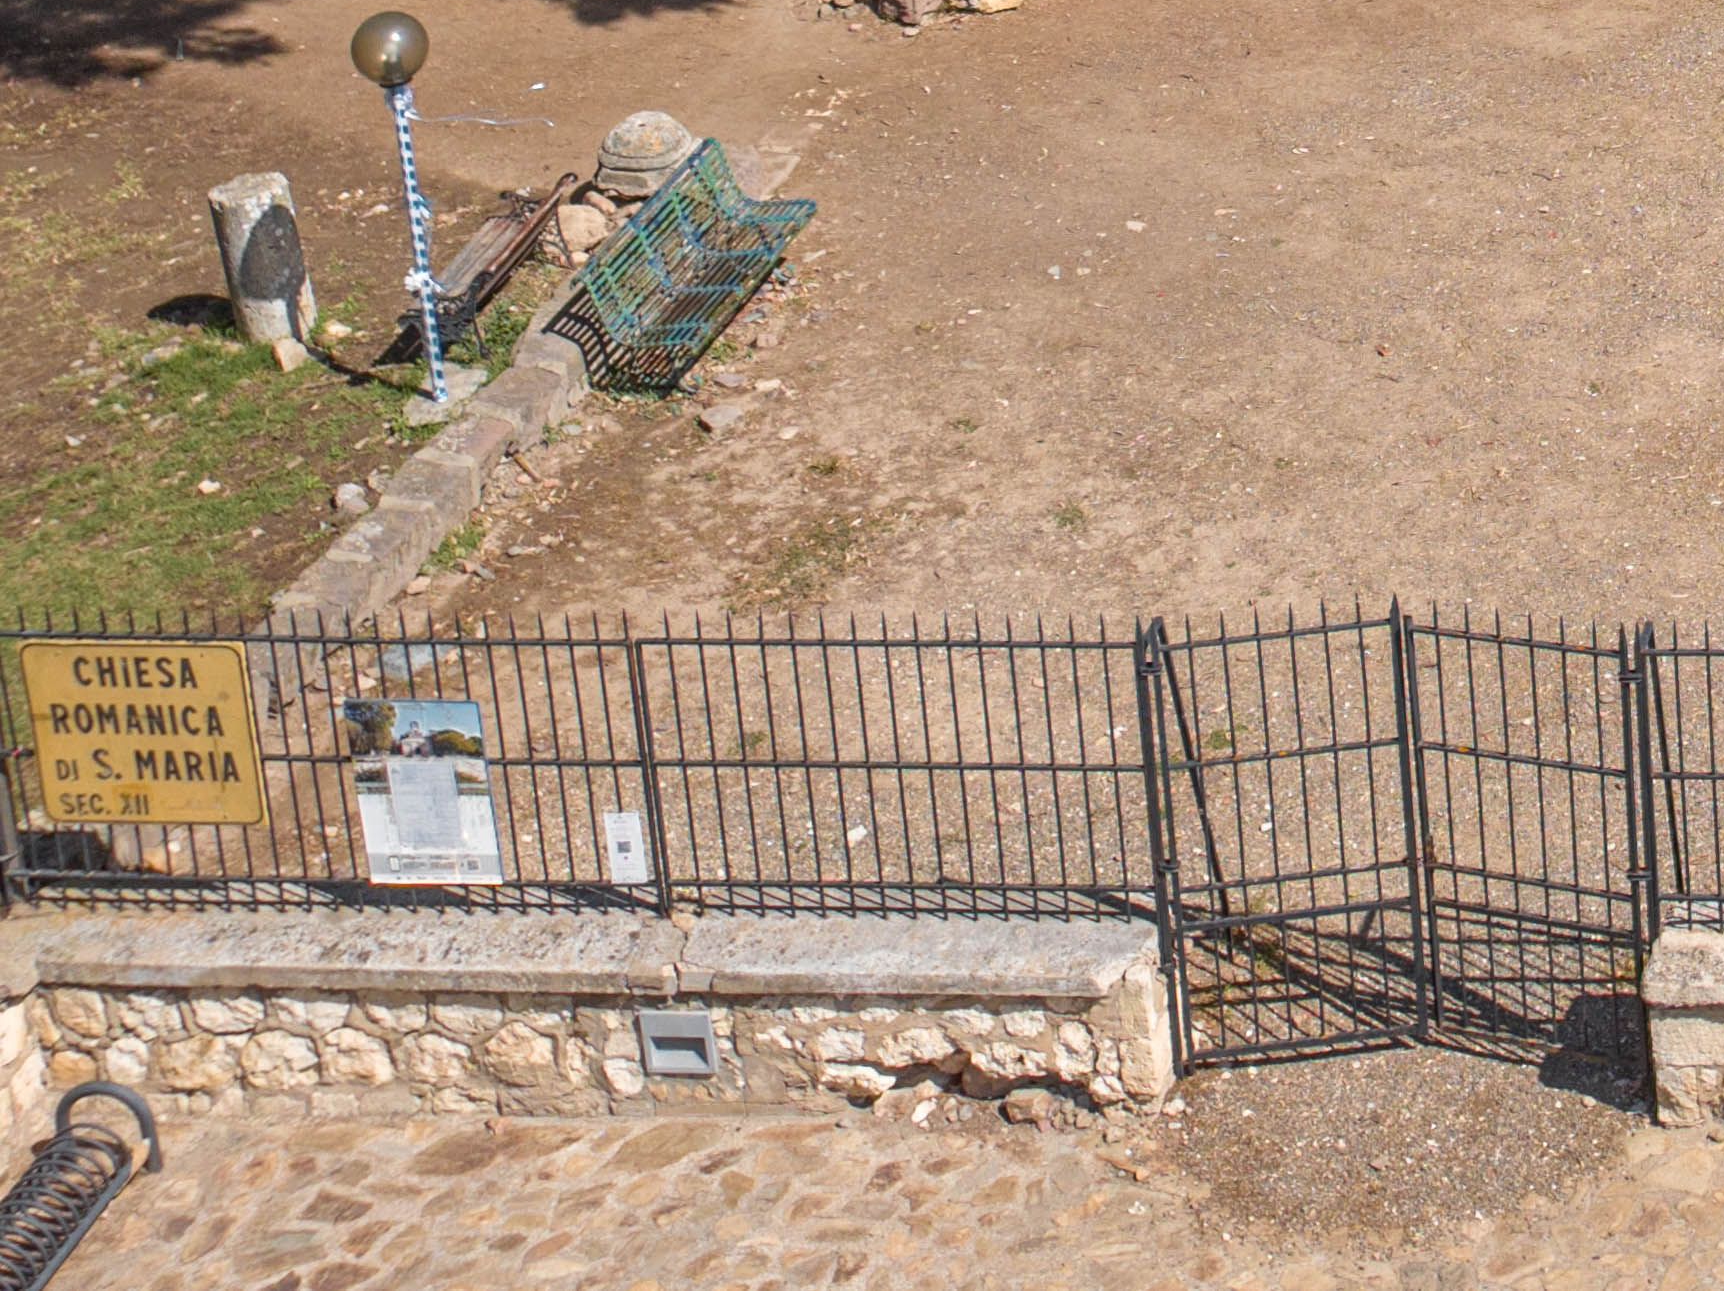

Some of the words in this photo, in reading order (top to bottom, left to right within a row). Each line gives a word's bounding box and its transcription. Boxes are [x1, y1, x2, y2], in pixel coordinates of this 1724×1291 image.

[73, 656, 198, 689] CHIESA
[50, 703, 224, 737] ROMANICA
[56, 759, 79, 781] DI
[92, 749, 122, 781] S.
[134, 750, 240, 783] MARIA
[59, 793, 112, 815] SEC.
[120, 793, 150, 815] XII
